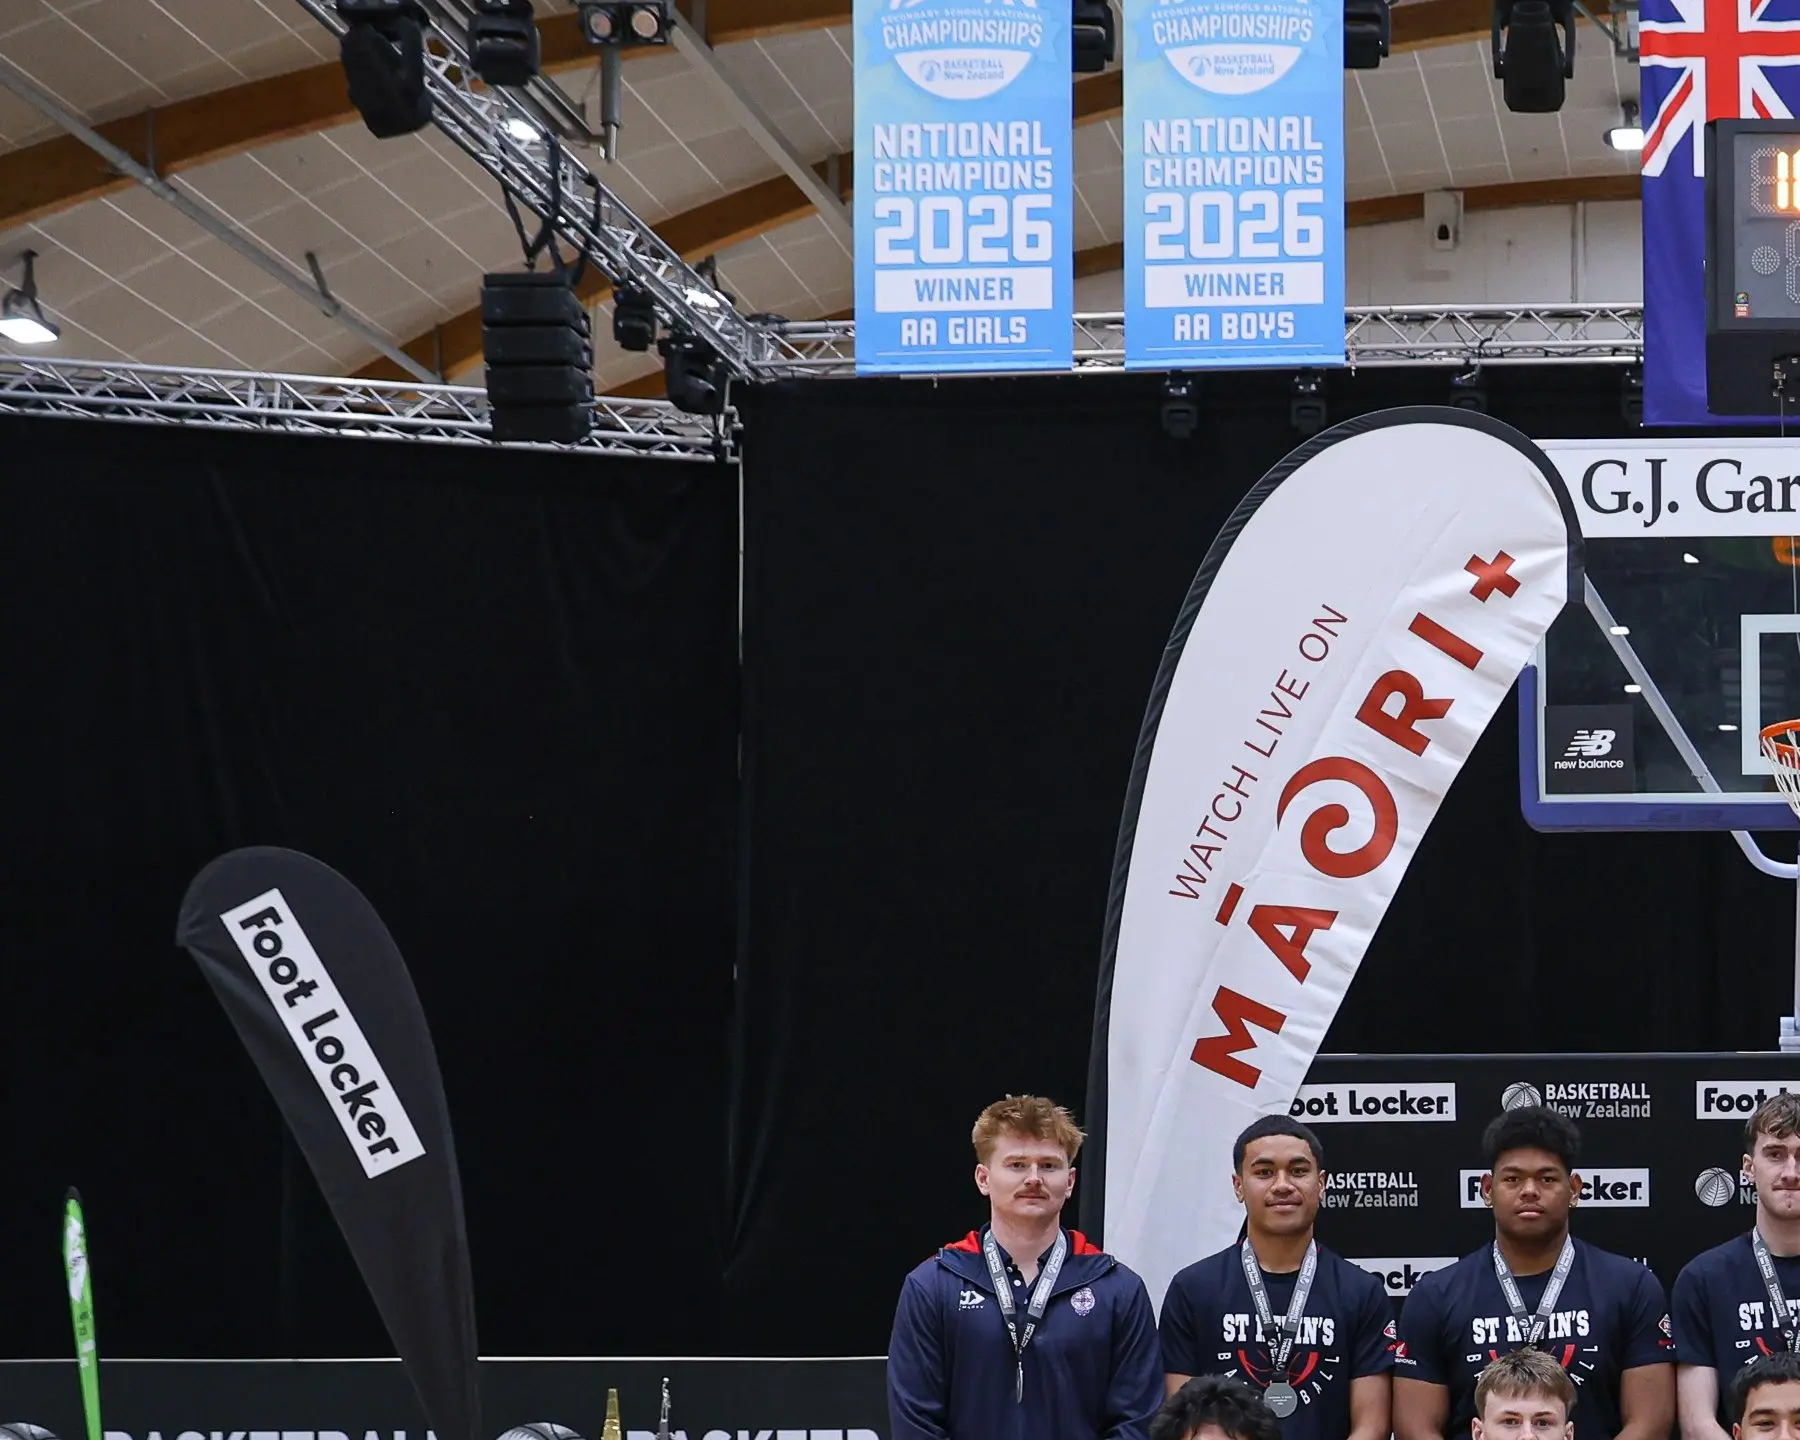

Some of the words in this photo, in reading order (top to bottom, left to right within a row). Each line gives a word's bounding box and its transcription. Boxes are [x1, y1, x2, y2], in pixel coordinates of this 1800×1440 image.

[883, 19, 1043, 49] CHAMPIONSHIPS
[1153, 14, 1313, 44] CHAMPIONSHIPS
[1213, 54, 1274, 64] BASKETBALL
[874, 121, 1052, 158] NATIONAL
[1144, 116, 1323, 155] NATIONAL
[874, 161, 1052, 192] CHAMPIONS
[1144, 156, 1323, 187] CHAMPIONS
[875, 195, 1052, 264] 2026
[1145, 189, 1323, 260] 2026
[916, 277, 1013, 301] WINNER
[1185, 273, 1284, 297] WINNER
[901, 319, 938, 345] AA
[948, 317, 1026, 344] GIRLS
[1174, 313, 1210, 341] AA
[1222, 312, 1295, 339] BOYS
[1582, 459, 1680, 527] G.J.
[1169, 765, 1259, 900] WATCH
[1243, 669, 1310, 758] LIVE
[1298, 604, 1348, 663] ON
[1554, 761, 1577, 770] new
[1579, 758, 1624, 769] balance
[238, 905, 320, 1008] Foot
[301, 1008, 400, 1158] Locker
[1289, 1091, 1338, 1116] oot
[1348, 1090, 1449, 1116] Locker
[1545, 1083, 1650, 1099] BASKETBALL
[1586, 1101, 1651, 1118] Zealand
[1325, 1172, 1418, 1189] ASKETBALL
[1578, 1174, 1641, 1200] cker
[1354, 1190, 1418, 1207] Zealand
[1223, 1314, 1249, 1342] ST
[1739, 1302, 1764, 1331] ST
[1472, 1317, 1500, 1345] ST
